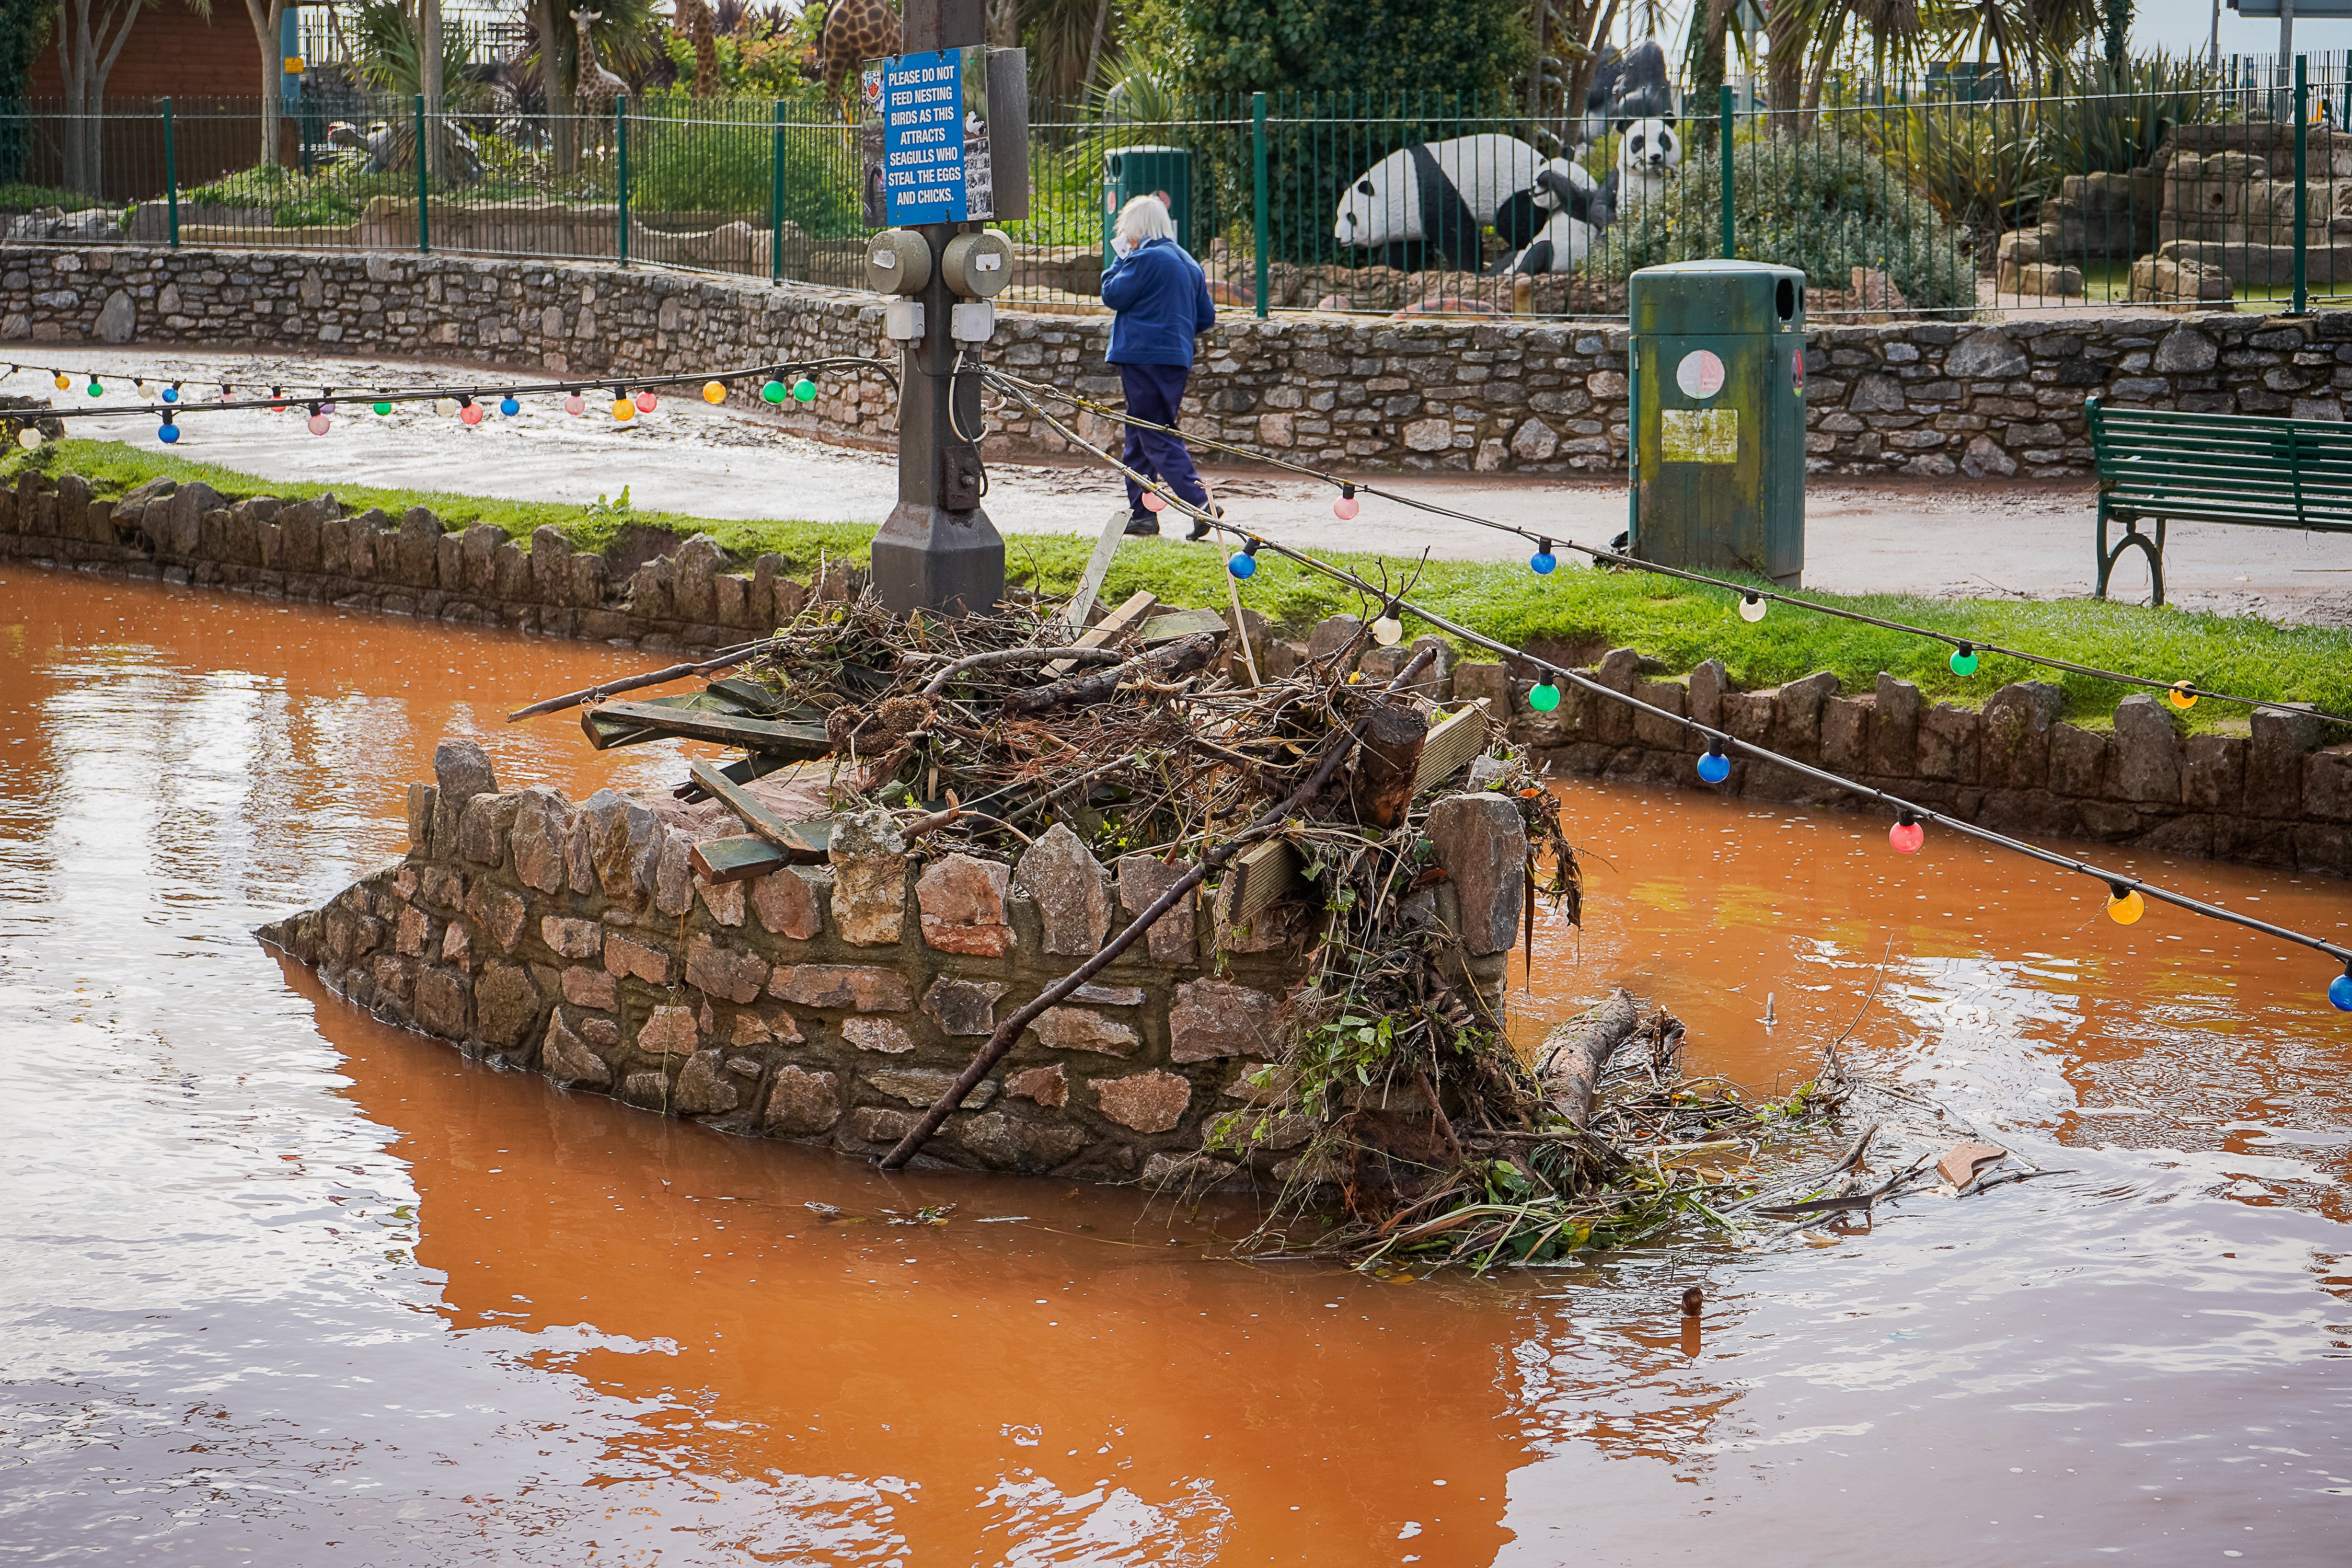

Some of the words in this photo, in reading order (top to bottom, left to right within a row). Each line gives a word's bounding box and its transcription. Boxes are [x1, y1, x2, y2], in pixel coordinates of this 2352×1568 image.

[889, 70, 920, 86] PLEASE
[922, 68, 935, 82] DO
[937, 65, 954, 80] NOT
[892, 90, 913, 106] FEED
[915, 86, 952, 103] NESTING
[891, 110, 917, 126] BIRDS
[919, 109, 932, 123] AS
[933, 106, 954, 121] THIS
[900, 128, 946, 145] ATTRACTS
[890, 148, 935, 166] SEAGULLS
[936, 146, 958, 162] WHO
[889, 171, 916, 187] STEAL
[917, 169, 935, 183] THE
[937, 167, 961, 182] EGGS
[897, 191, 916, 205] AND
[918, 188, 954, 204] CHICKS.
